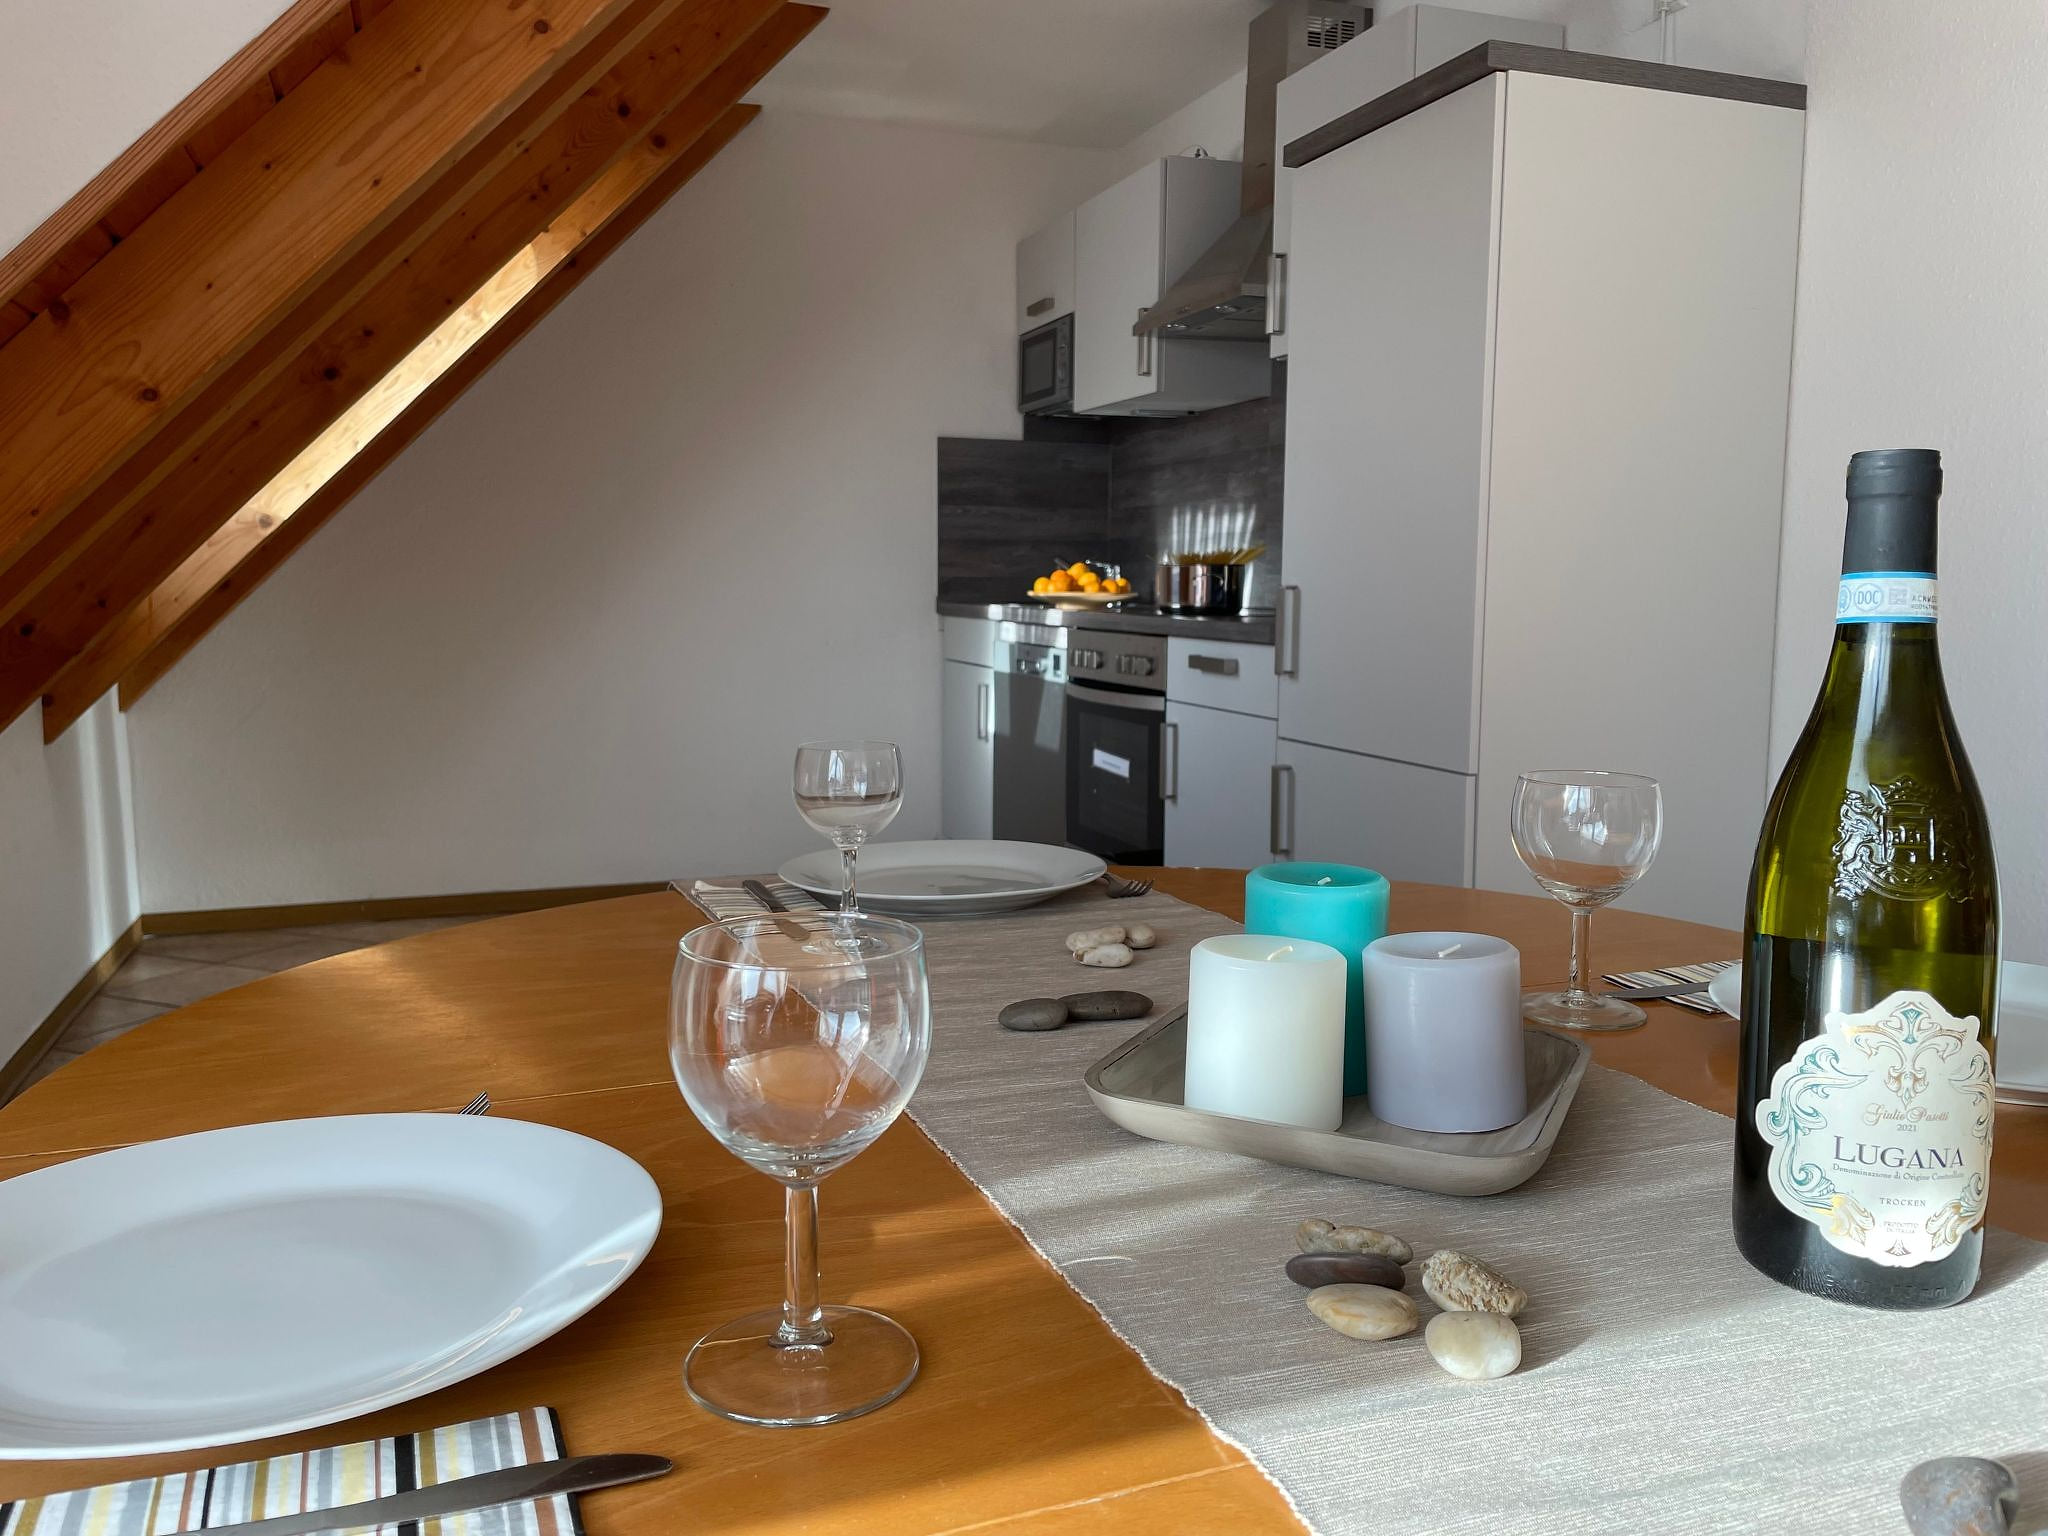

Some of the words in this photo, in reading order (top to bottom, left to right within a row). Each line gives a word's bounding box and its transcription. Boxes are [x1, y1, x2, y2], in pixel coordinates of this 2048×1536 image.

[1857, 590, 1880, 605] DOC
[1863, 1103, 1904, 1126] Giulio
[1896, 1123, 1917, 1132] 2021
[1833, 1135, 1964, 1169] LUGANA
[1833, 1163, 1892, 1179] Denominazione
[1894, 1171, 1901, 1179] di
[1903, 1172, 1930, 1182] Origine
[1880, 1197, 1926, 1207] TROCKEN
